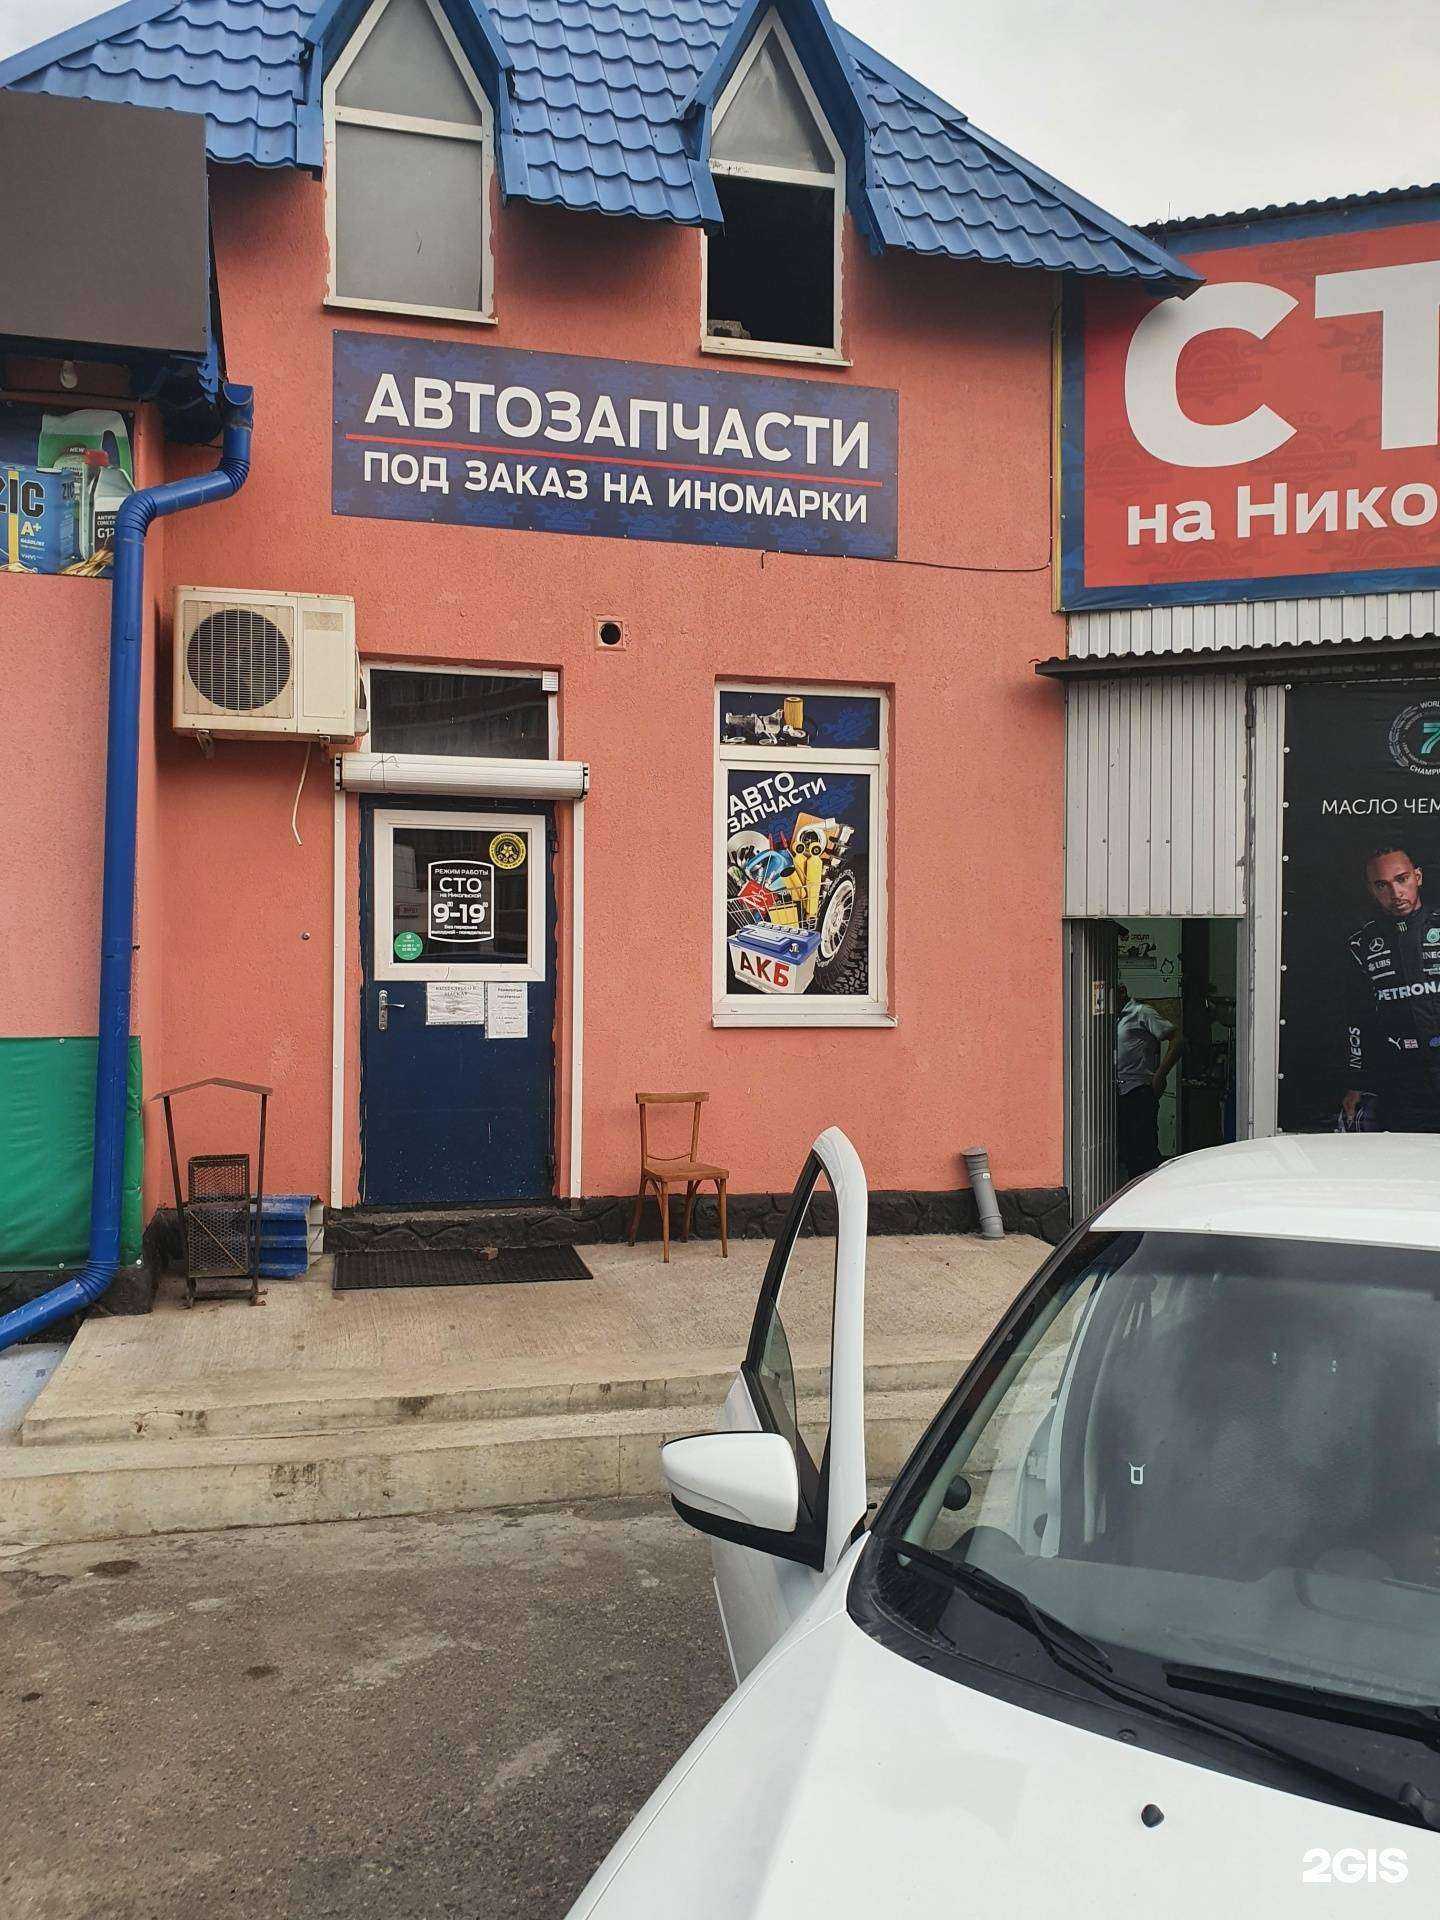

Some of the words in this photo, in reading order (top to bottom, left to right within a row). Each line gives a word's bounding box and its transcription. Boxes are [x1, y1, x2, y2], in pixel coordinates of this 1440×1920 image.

[1125, 260, 1440, 468] СТ
[364, 373, 869, 470] АВТОЗАПЧАСТИ
[364, 451, 449, 494] ПОД
[464, 459, 589, 500] ЗАКАЗ
[603, 472, 653, 506] НА
[668, 478, 867, 524] ИНОМАРКИ
[1127, 498, 1215, 546] на
[1237, 482, 1439, 539] Нико
[728, 772, 795, 814] АВТО
[728, 777, 827, 833] ЗАПЧАСТИ
[1321, 798, 1397, 815] МАСЛО
[439, 877, 482, 893] СТО
[740, 950, 790, 988] АКБ
[1349, 1026, 1362, 1069] INEOS
